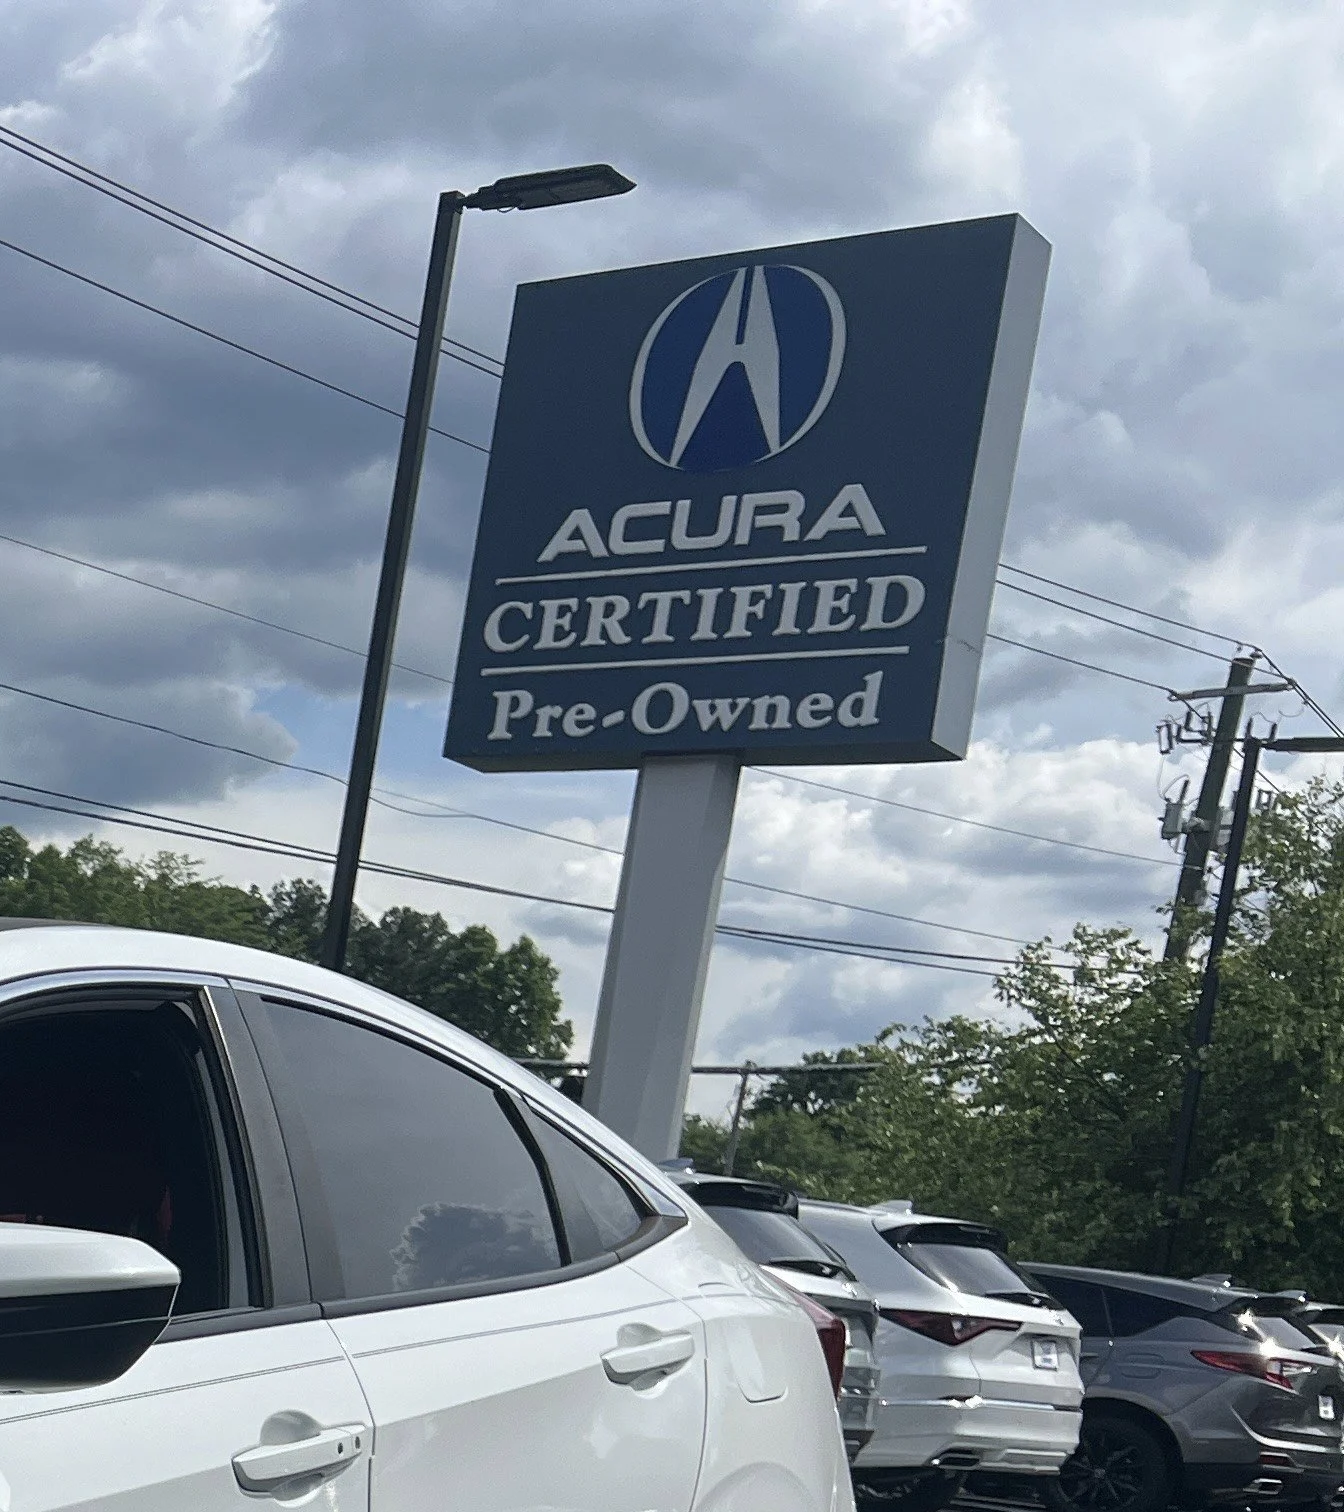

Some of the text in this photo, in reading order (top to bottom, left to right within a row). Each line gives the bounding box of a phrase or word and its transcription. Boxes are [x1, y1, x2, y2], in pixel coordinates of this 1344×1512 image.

[537, 484, 886, 562] ACURA
[483, 575, 927, 654] CERTIFIED
[488, 670, 884, 741] Pre-Owned
